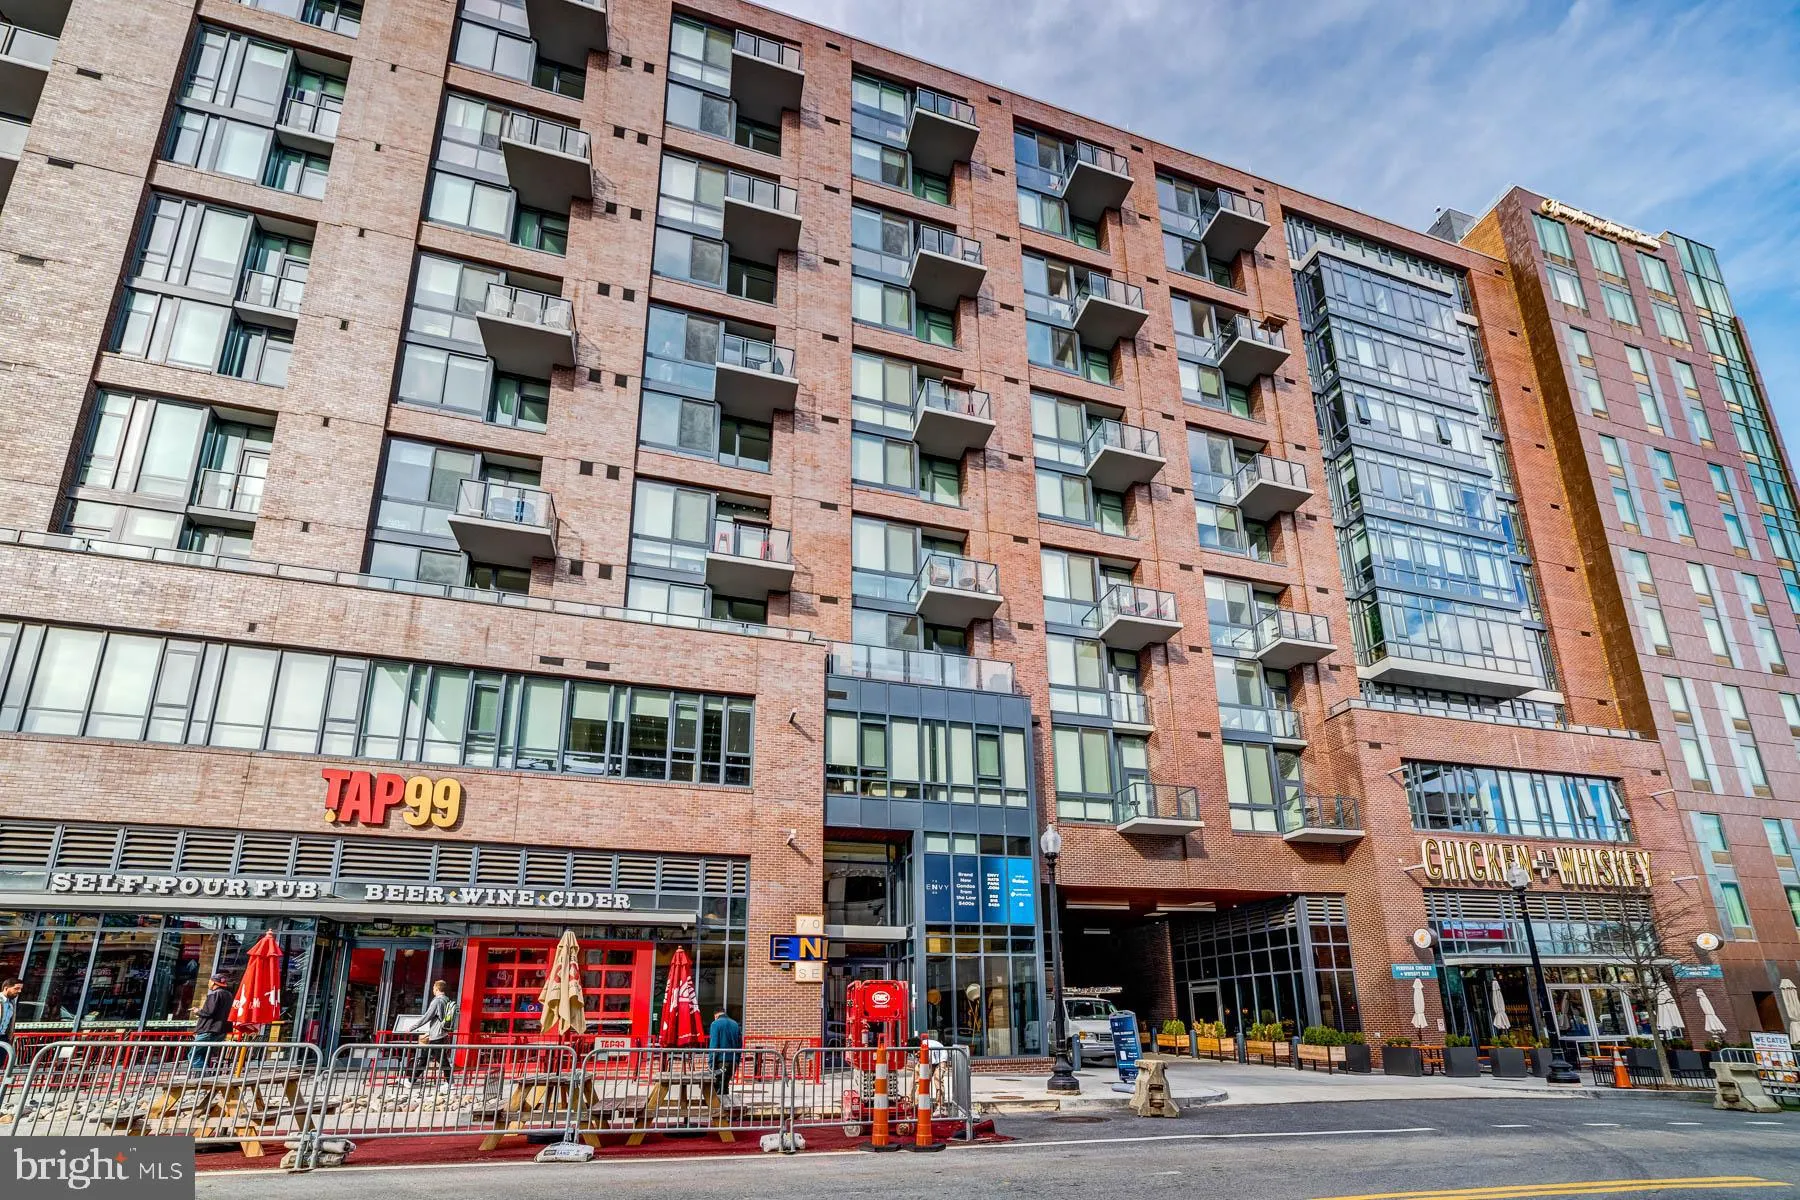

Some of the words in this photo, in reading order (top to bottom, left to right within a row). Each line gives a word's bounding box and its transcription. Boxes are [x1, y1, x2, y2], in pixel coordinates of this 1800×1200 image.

[322, 768, 461, 827] TAP99
[1422, 838, 1533, 882] CHICKEN
[1553, 847, 1653, 887] WHISKEY
[52, 873, 249, 896] SELF-POUR
[254, 880, 319, 898] PUB
[365, 884, 445, 902] BEER
[460, 888, 535, 906] WINE
[549, 891, 631, 909] CIDER
[798, 968, 820, 979] SE
